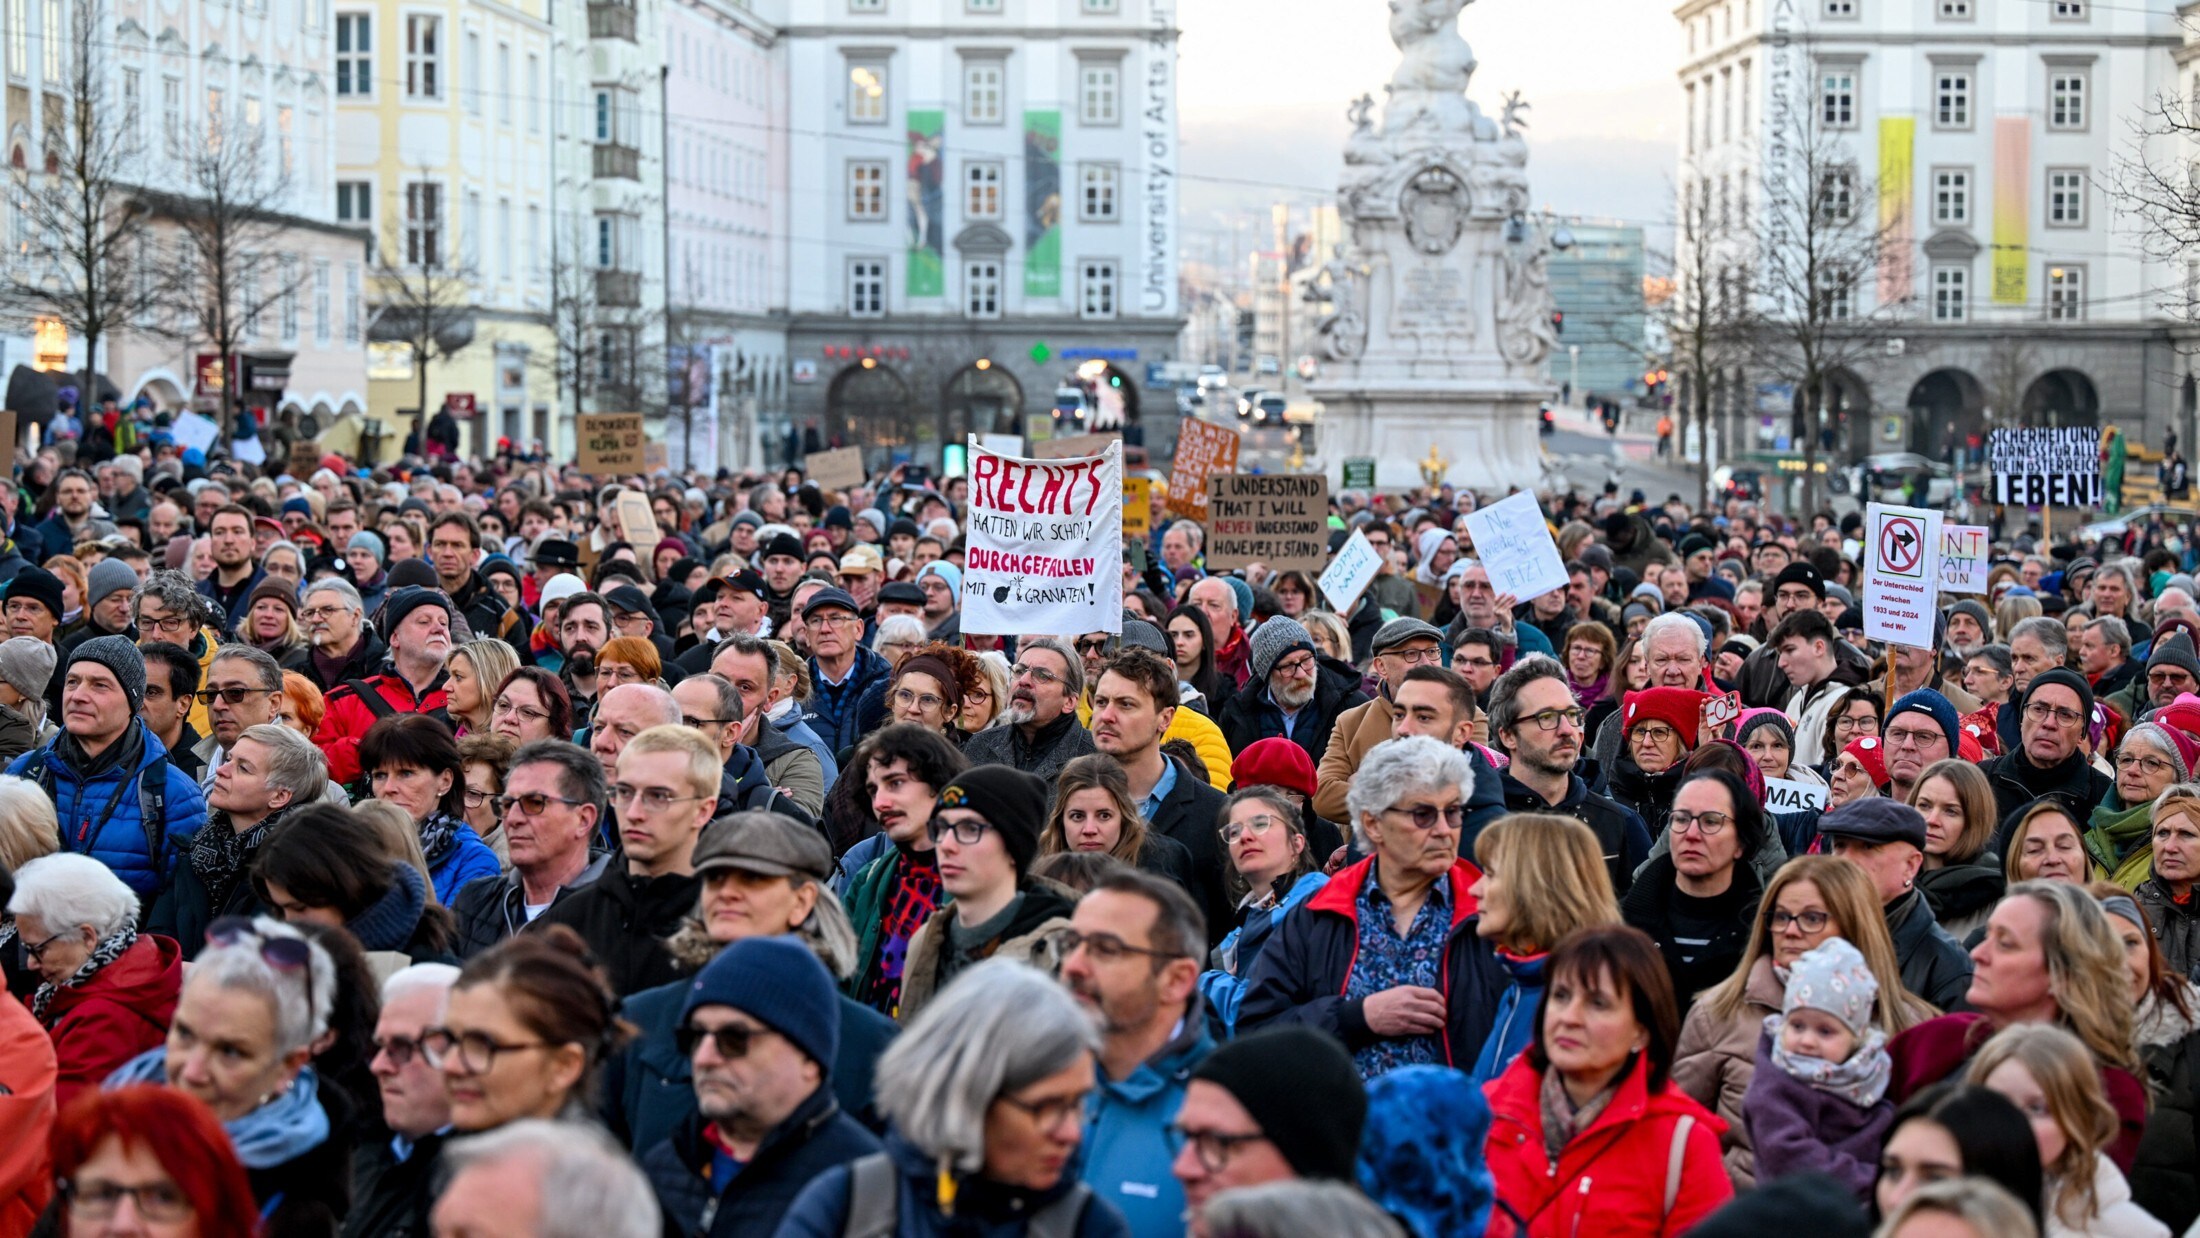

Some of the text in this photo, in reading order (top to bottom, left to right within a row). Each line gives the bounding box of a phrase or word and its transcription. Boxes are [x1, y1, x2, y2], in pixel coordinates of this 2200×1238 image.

[1145, 60, 1168, 124] Arts
[1146, 130, 1167, 158] of
[1144, 165, 1172, 312] University
[1990, 427, 2100, 443] SICHERHEIT UND
[1991, 443, 2046, 457] FAIRNESS
[2073, 443, 2099, 457] ALLE
[1991, 459, 2010, 472] DIE
[2012, 460, 2024, 472] IN
[975, 455, 1104, 516] RECHTS
[1214, 477, 1319, 497] I UNDERSTAND
[1991, 474, 2100, 505] LEBEN!
[1212, 500, 1306, 517] THAT I WILL
[972, 512, 1018, 538] HATTEN
[1023, 520, 1045, 541] WIR
[1214, 520, 1319, 535] NEVER UNDERSTAND
[1284, 541, 1319, 557] STAND
[1482, 534, 1520, 558] wieder
[968, 546, 1095, 578] DURCHGEFALLEN
[1322, 539, 1358, 593] STOPPT
[1500, 556, 1543, 590] JETZT
[965, 581, 987, 596] MIT
[1872, 578, 1924, 592] Der Unterschied
[1881, 595, 1911, 604] zwischen
[1873, 606, 1887, 614] 1933
[1902, 611, 1919, 619] 2024
[1881, 621, 1907, 631] sind Wir
